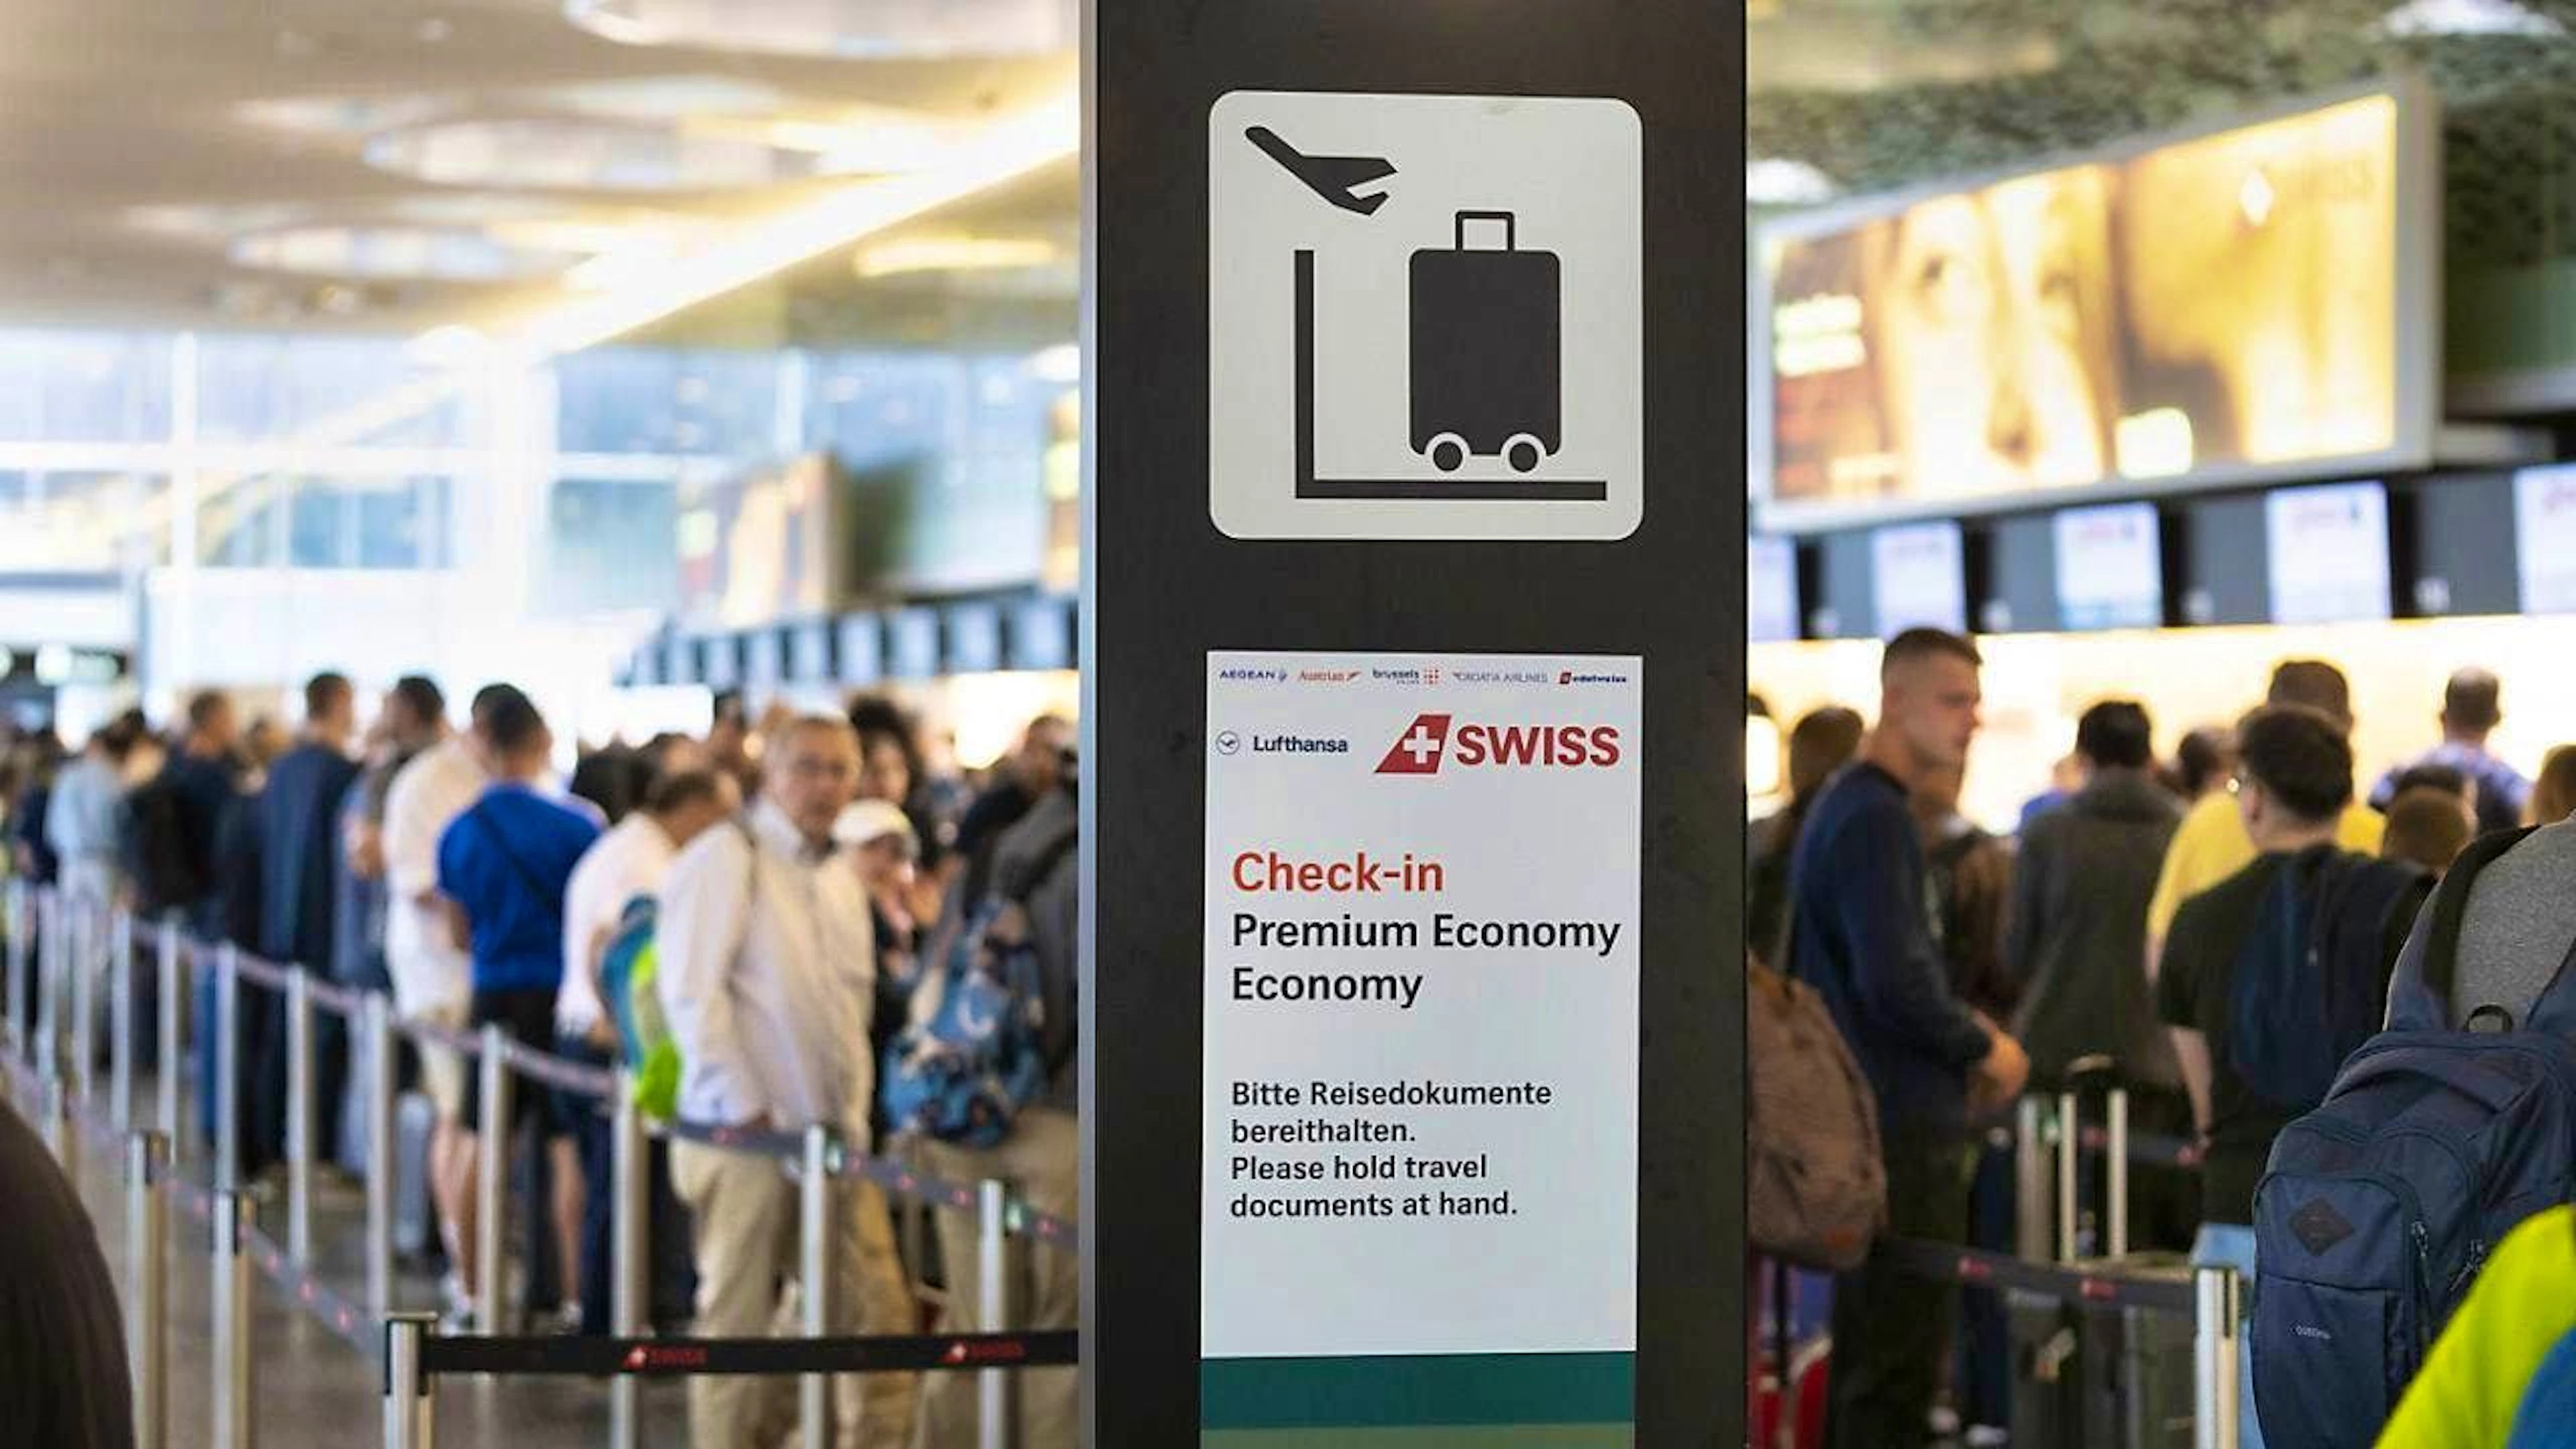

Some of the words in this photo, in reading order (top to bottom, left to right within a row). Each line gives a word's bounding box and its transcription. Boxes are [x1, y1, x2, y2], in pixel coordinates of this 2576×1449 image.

[1219, 669, 1274, 680] AEGEAN
[1299, 670, 1344, 681] Austrian
[1372, 669, 1419, 680] brussels
[1253, 735, 1348, 754] Lufthansa
[1456, 724, 1620, 767] SWISS
[1232, 851, 1444, 892] Check-in
[1234, 913, 1417, 947] Premium
[1434, 913, 1621, 957] Economy
[1233, 967, 1424, 1009] Economy
[1232, 1081, 1301, 1107] Bitte
[1311, 1080, 1552, 1106] Reisedokumente
[1232, 1118, 1416, 1143] bereithalten.
[1232, 1155, 1325, 1180] Please
[1334, 1153, 1395, 1179] hold
[1405, 1153, 1487, 1179] travel
[1231, 1192, 1393, 1218] documents
[1402, 1193, 1431, 1217] at
[1439, 1190, 1518, 1216] hand.
